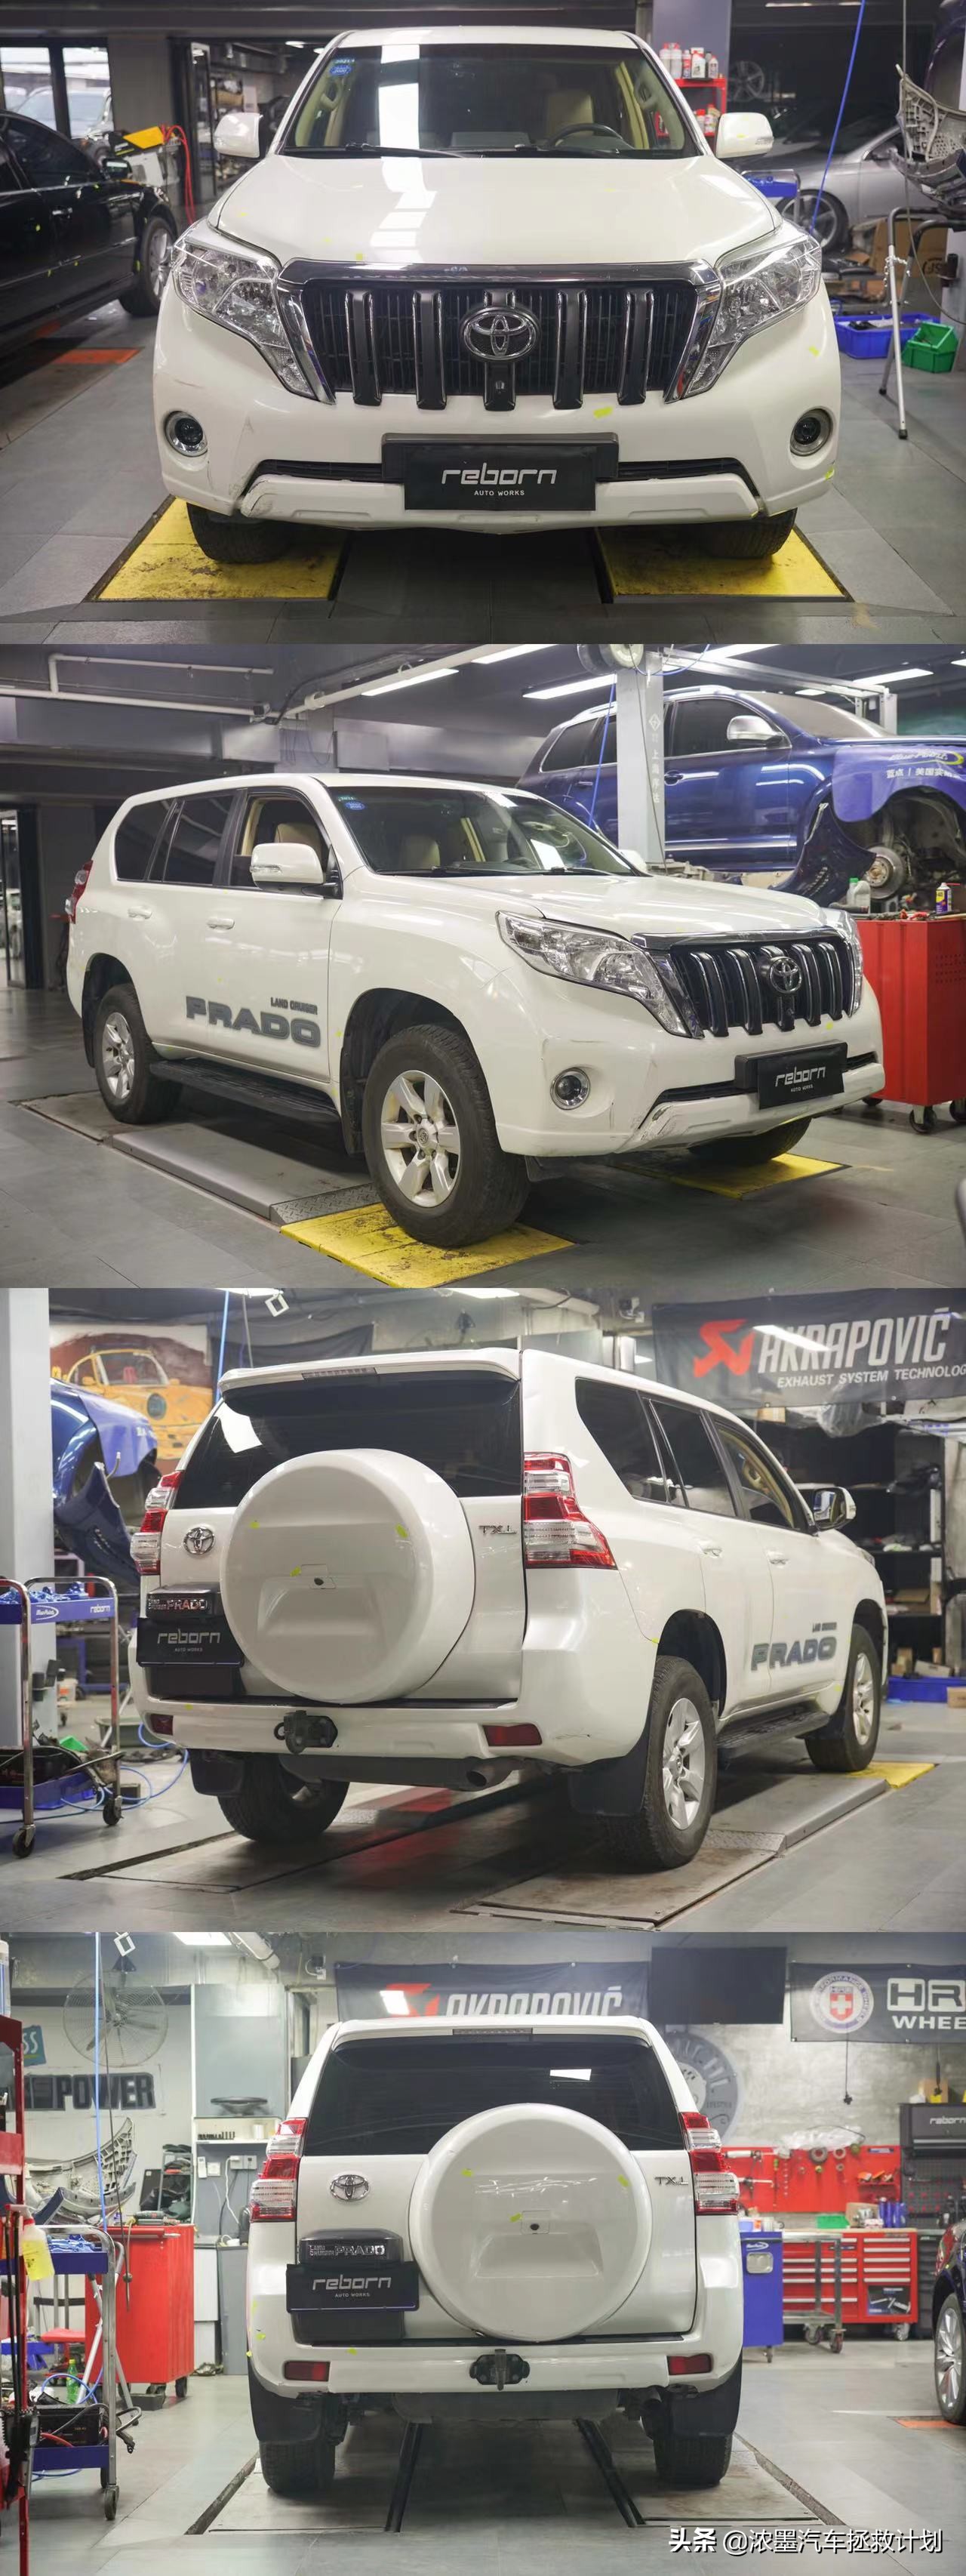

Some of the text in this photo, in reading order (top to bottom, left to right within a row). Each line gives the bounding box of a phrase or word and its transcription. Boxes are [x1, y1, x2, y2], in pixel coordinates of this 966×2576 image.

[441, 462, 557, 485] reborn
[270, 997, 318, 1015] LAND CRUISER
[186, 996, 321, 1048] PRADO
[775, 1066, 826, 1087] reborn
[777, 1363, 966, 1388] EXHAUST SYSTEM TECHNOLOG
[167, 1598, 208, 1610] PRADO
[157, 1628, 220, 1644] reborn
[751, 1636, 838, 1671] PRADO
[892, 2015, 966, 2030] WHEE
[334, 2245, 386, 2256] PRADO
[312, 2274, 392, 2291] reborn
